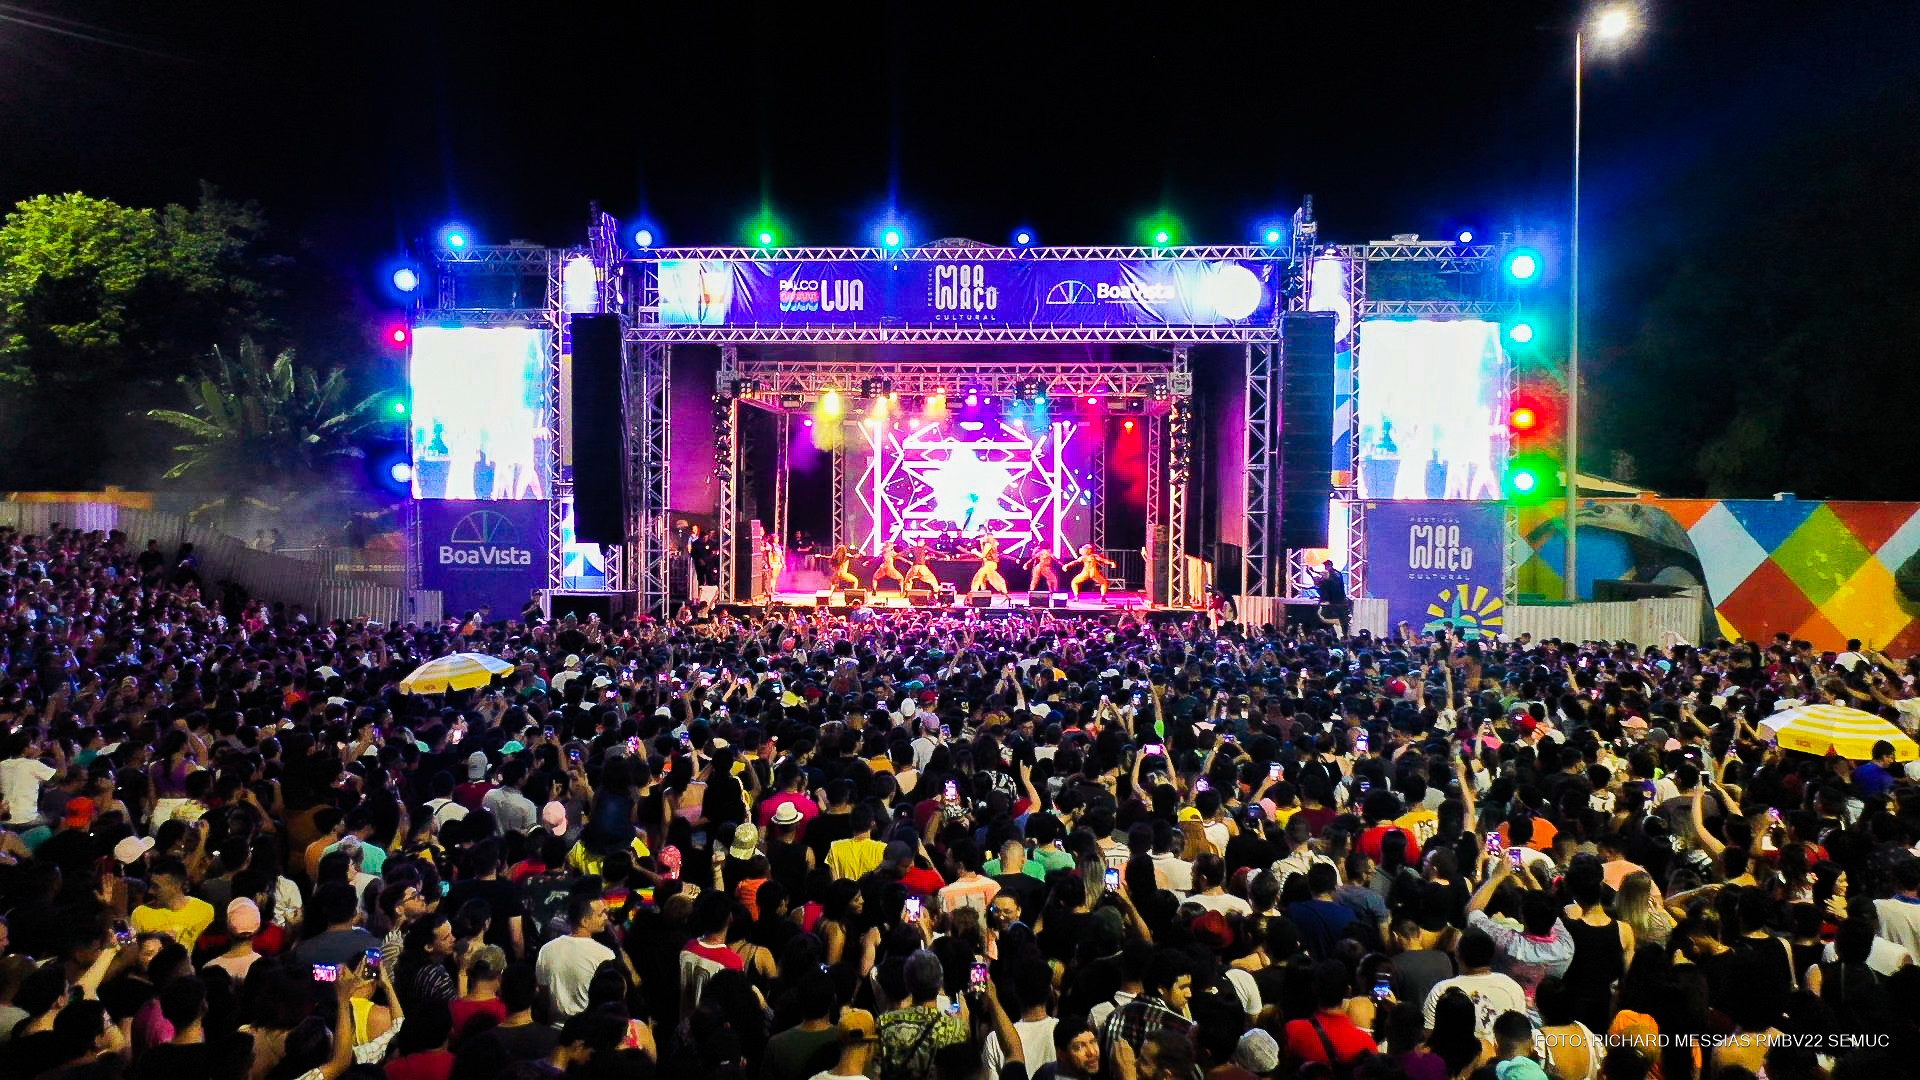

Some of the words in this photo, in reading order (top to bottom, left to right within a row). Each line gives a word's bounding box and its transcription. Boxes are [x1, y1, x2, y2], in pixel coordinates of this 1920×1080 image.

[779, 279, 819, 291] PALCO
[821, 279, 864, 312] LUA
[439, 546, 531, 564] BoaVista
